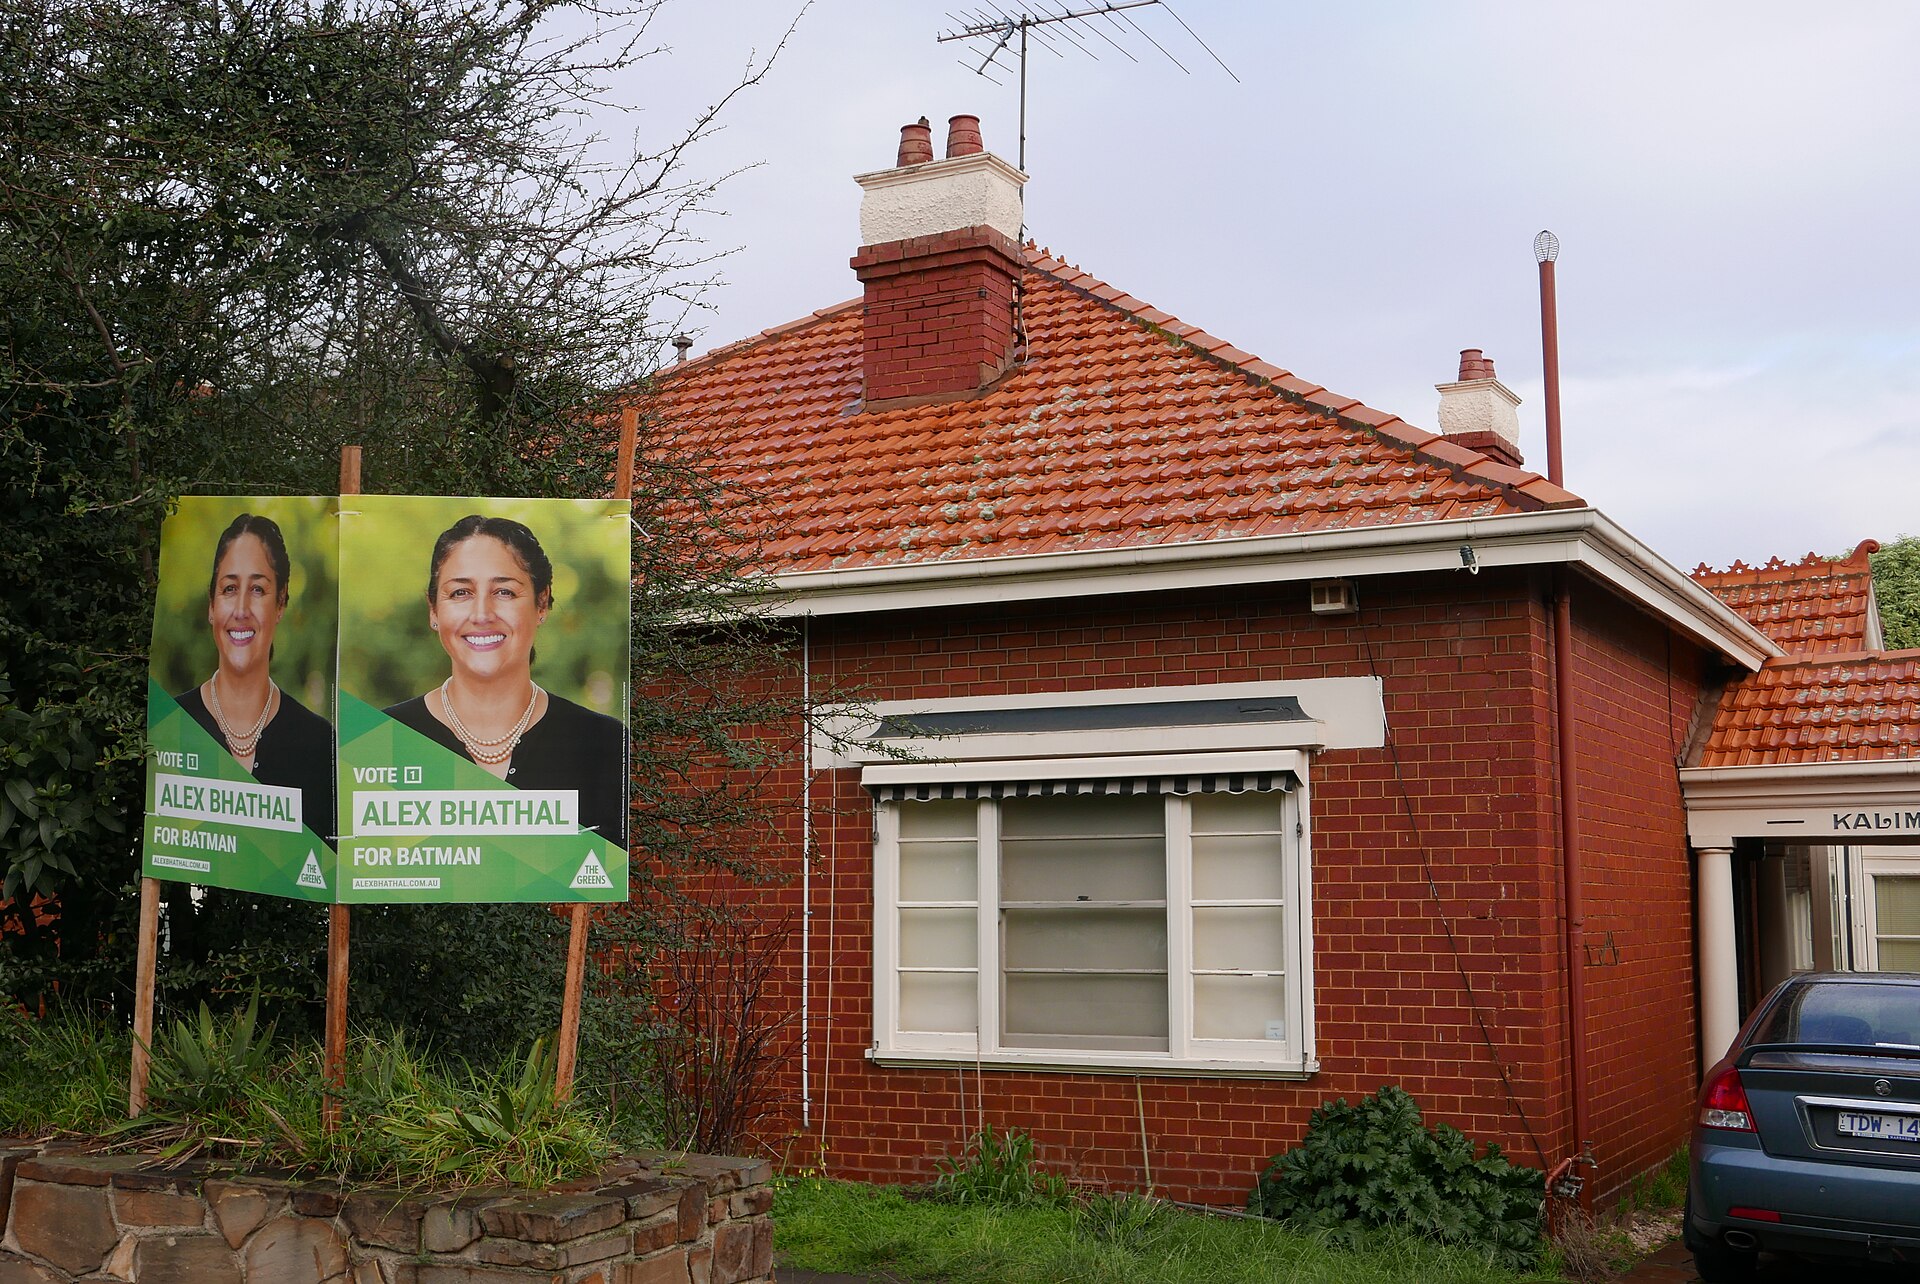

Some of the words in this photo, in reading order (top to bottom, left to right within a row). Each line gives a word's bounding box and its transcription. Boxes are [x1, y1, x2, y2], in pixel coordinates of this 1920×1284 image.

[156, 751, 183, 768] VOTE
[353, 767, 398, 784] VOTE
[160, 783, 205, 811] ALEX
[210, 788, 296, 822] BHATHAL
[361, 800, 432, 826] ALEX
[440, 800, 570, 826] BHATHAL
[153, 826, 180, 846] FOR
[182, 829, 237, 853] BATMAN
[153, 857, 209, 870] ALEXBHATHAL.COM.AU
[353, 847, 392, 866] FOR
[396, 846, 481, 865] BATMAN
[307, 864, 317, 874] THE
[584, 865, 599, 875] THE
[301, 873, 322, 885] GREENS
[354, 880, 438, 888] ALEXBHATHAL.COM.AU
[576, 875, 606, 885] GREENS
